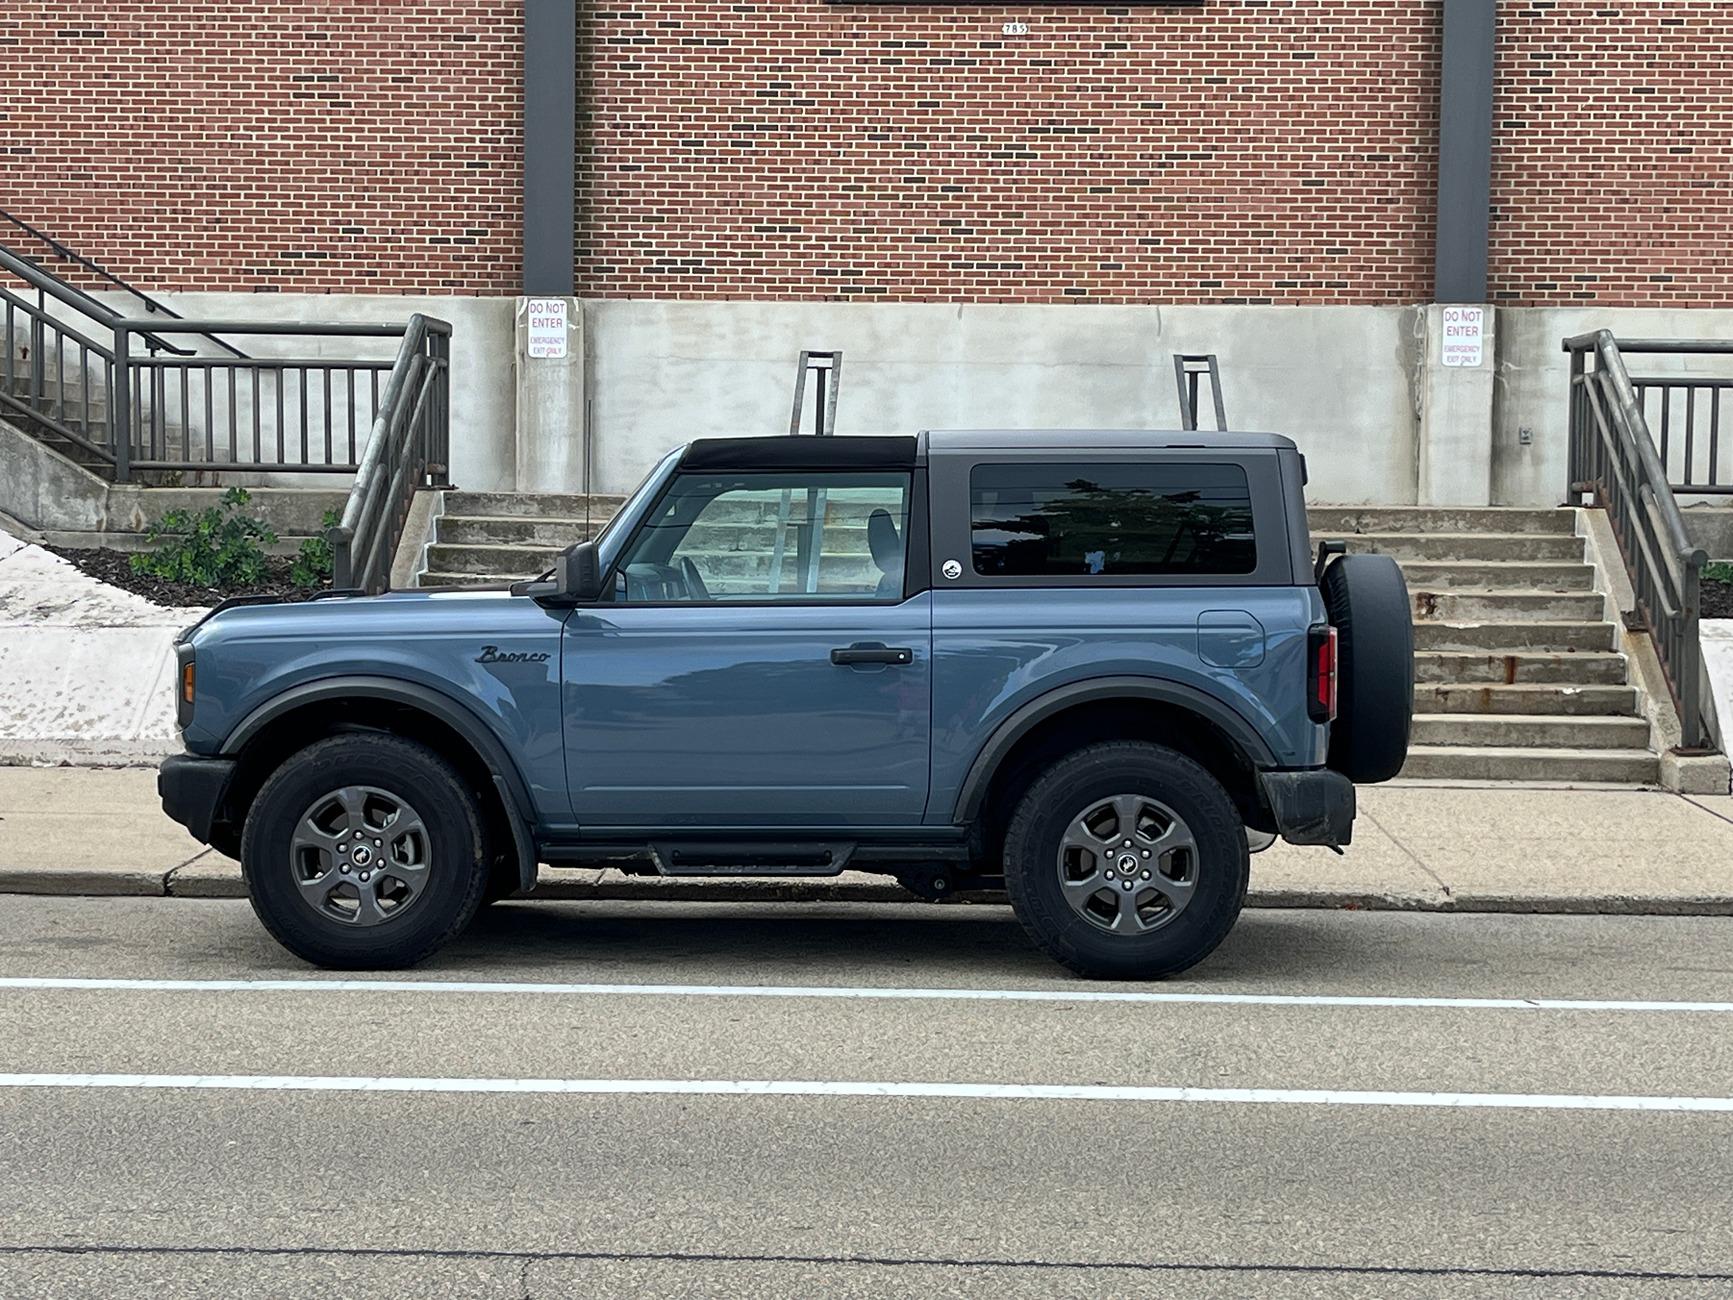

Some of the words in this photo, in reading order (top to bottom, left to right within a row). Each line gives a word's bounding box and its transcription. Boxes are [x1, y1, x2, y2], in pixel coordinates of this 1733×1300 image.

[1005, 24, 1025, 33] 785
[530, 303, 543, 314] DO
[546, 303, 565, 314] NOT
[1445, 311, 1459, 322] DO
[1461, 311, 1481, 322] NOT
[532, 317, 563, 329] ENTER
[1446, 325, 1479, 337] ENTER
[474, 645, 552, 664] Bronco
